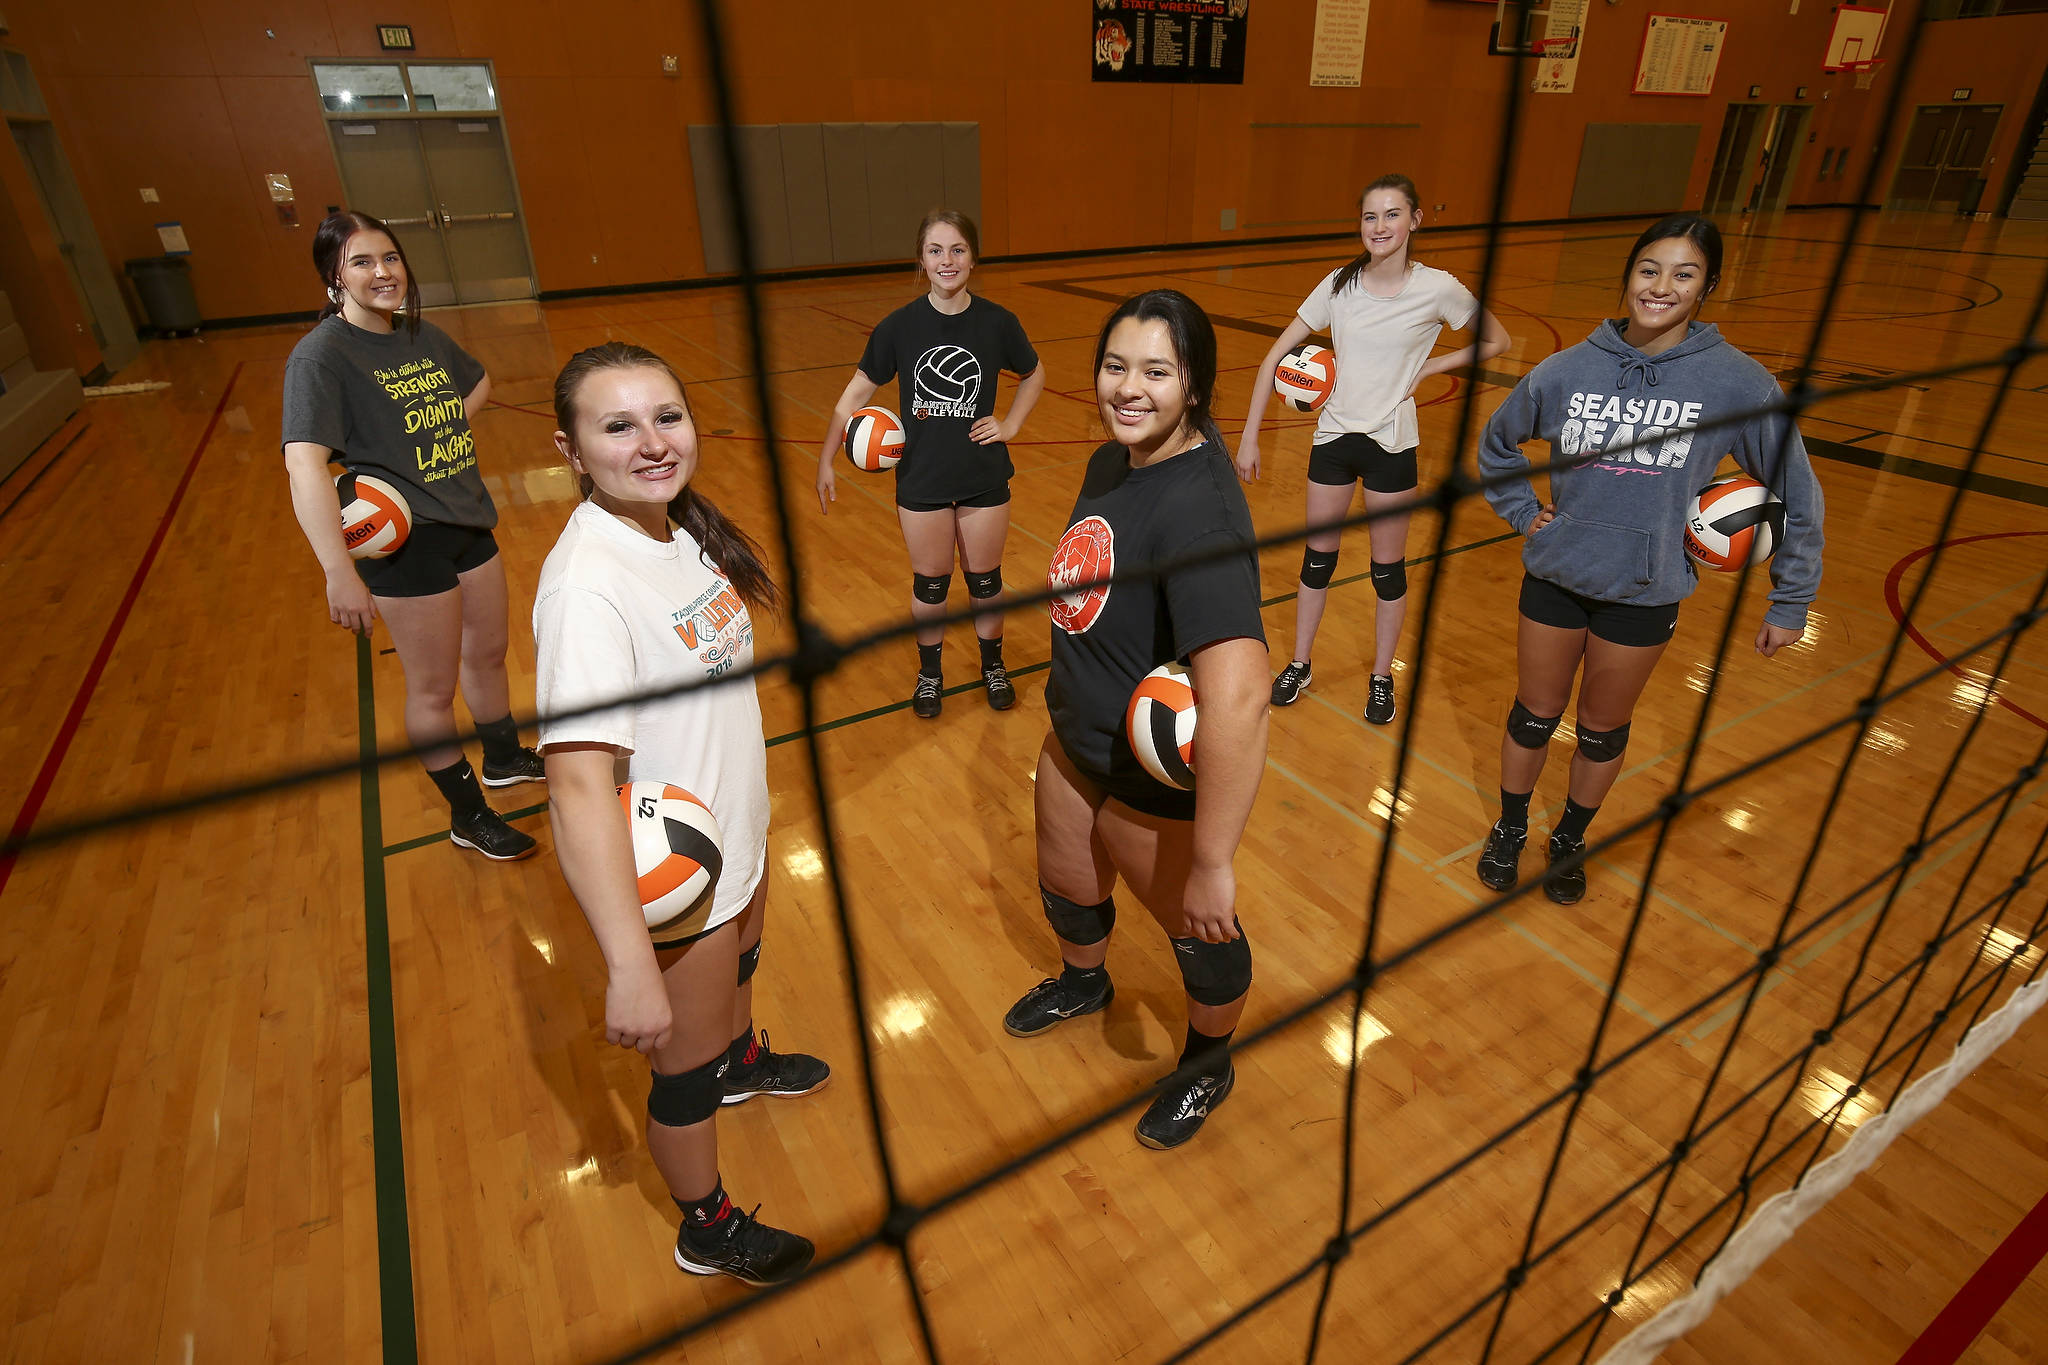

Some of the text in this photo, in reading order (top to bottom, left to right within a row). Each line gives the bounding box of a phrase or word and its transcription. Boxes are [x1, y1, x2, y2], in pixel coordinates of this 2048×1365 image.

[1122, 0, 1155, 10] STATE
[1160, 1, 1224, 14] WRESTLING
[385, 29, 408, 46] EXIT
[1295, 359, 1307, 370] L2
[385, 367, 451, 400] STRENGTH
[1280, 369, 1314, 387] molten
[404, 396, 464, 434] DIGNITY
[1567, 392, 1703, 428] SEASIDE
[416, 429, 474, 470] LAUGHS
[1560, 418, 1696, 469] BEACH
[1691, 517, 1705, 535] L2
[638, 797, 658, 819] L2
